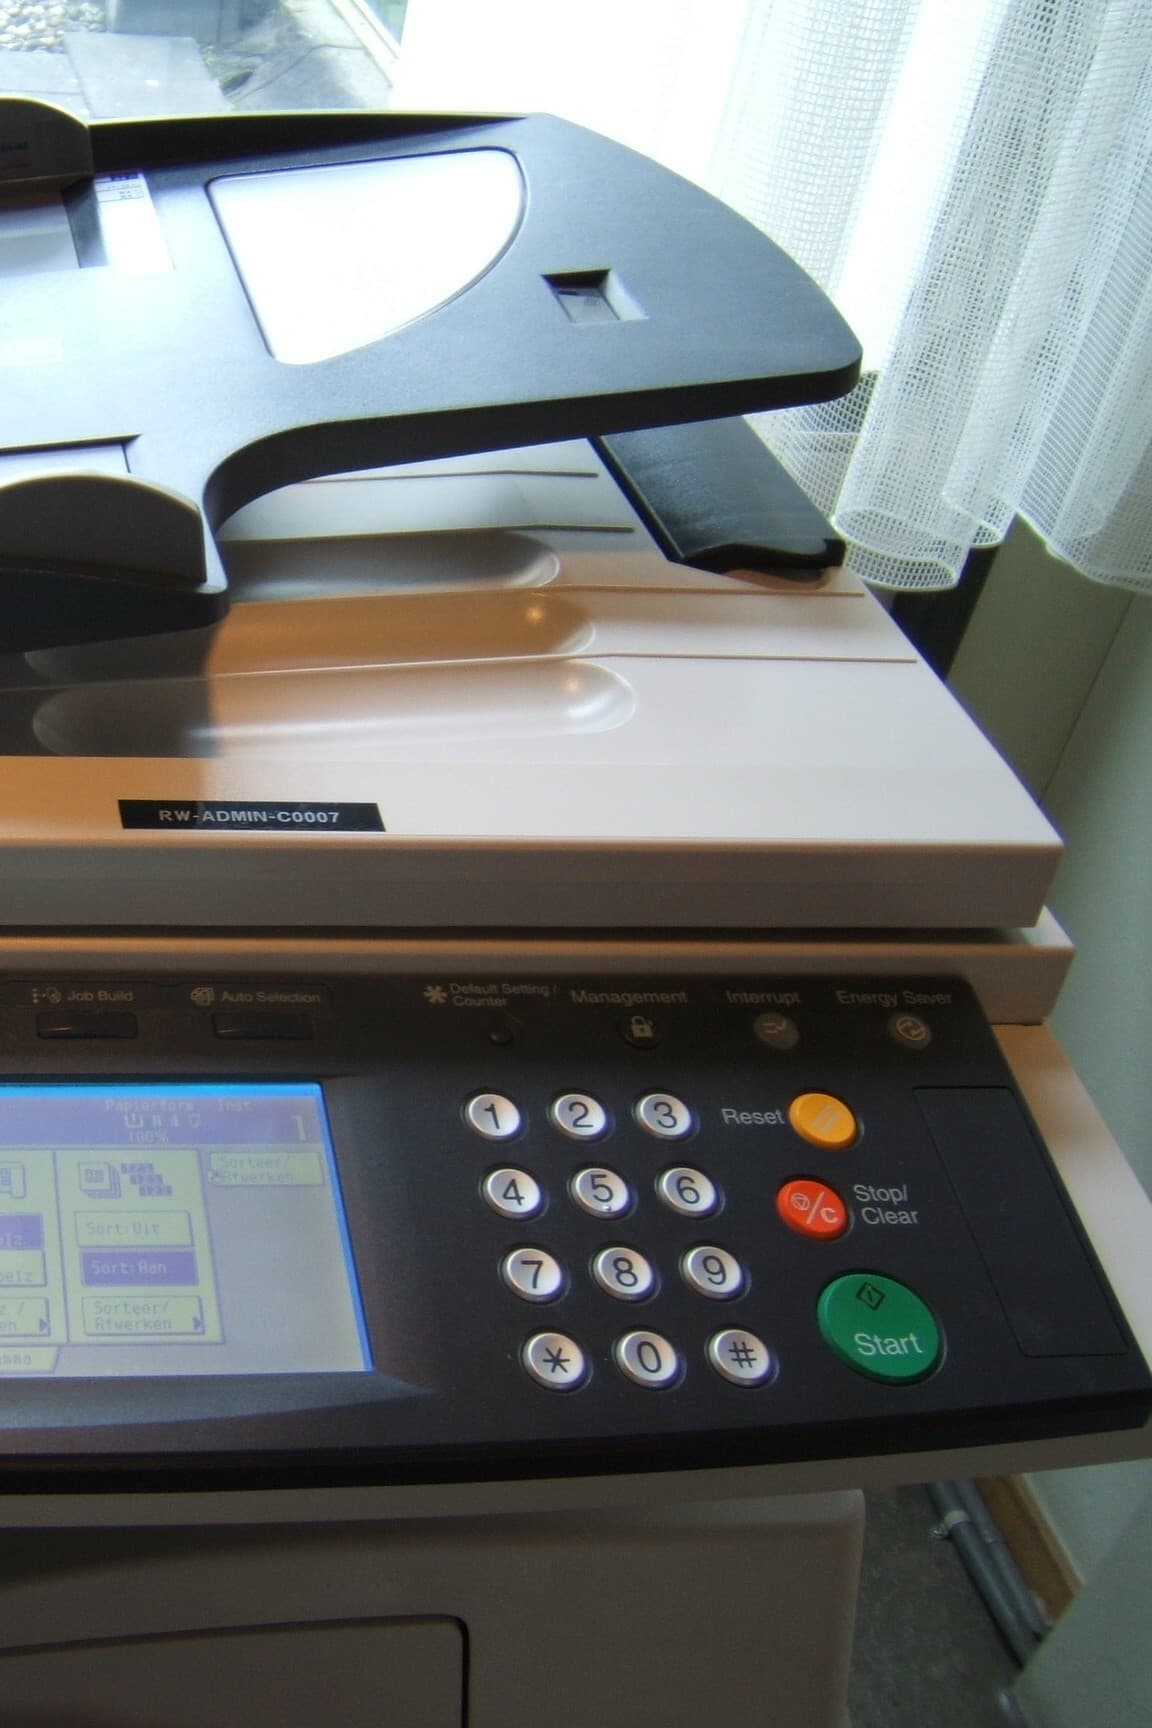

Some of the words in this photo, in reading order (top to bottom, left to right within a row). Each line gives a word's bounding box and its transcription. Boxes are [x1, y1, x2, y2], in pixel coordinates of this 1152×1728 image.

[159, 809, 339, 823] RW-ADMIN-C0007
[67, 990, 94, 1001] Job
[98, 990, 134, 1001] Build
[222, 991, 255, 1002] Auto
[259, 991, 321, 1003] Selection
[450, 983, 499, 994] Default
[502, 983, 550, 997] Setting
[453, 995, 508, 1006] Counter
[572, 990, 688, 1006] Management
[727, 990, 801, 1006] Interrupt
[836, 990, 897, 1007] Energy
[901, 990, 952, 1005] Saver
[291, 1115, 307, 1141] 1
[485, 1102, 500, 1130] 1
[569, 1101, 593, 1129] 2
[653, 1101, 678, 1130] 3
[722, 1107, 787, 1126] Reset
[502, 1178, 525, 1206] 4
[590, 1174, 613, 1202] 5
[676, 1175, 701, 1205] 6
[854, 1184, 909, 1206] Stop/
[861, 1206, 918, 1226] Clear
[521, 1259, 544, 1289] 7
[613, 1256, 638, 1288] 8
[702, 1255, 728, 1286] 9
[636, 1341, 661, 1374] 0
[730, 1341, 757, 1369] #
[854, 1332, 923, 1358] Start
